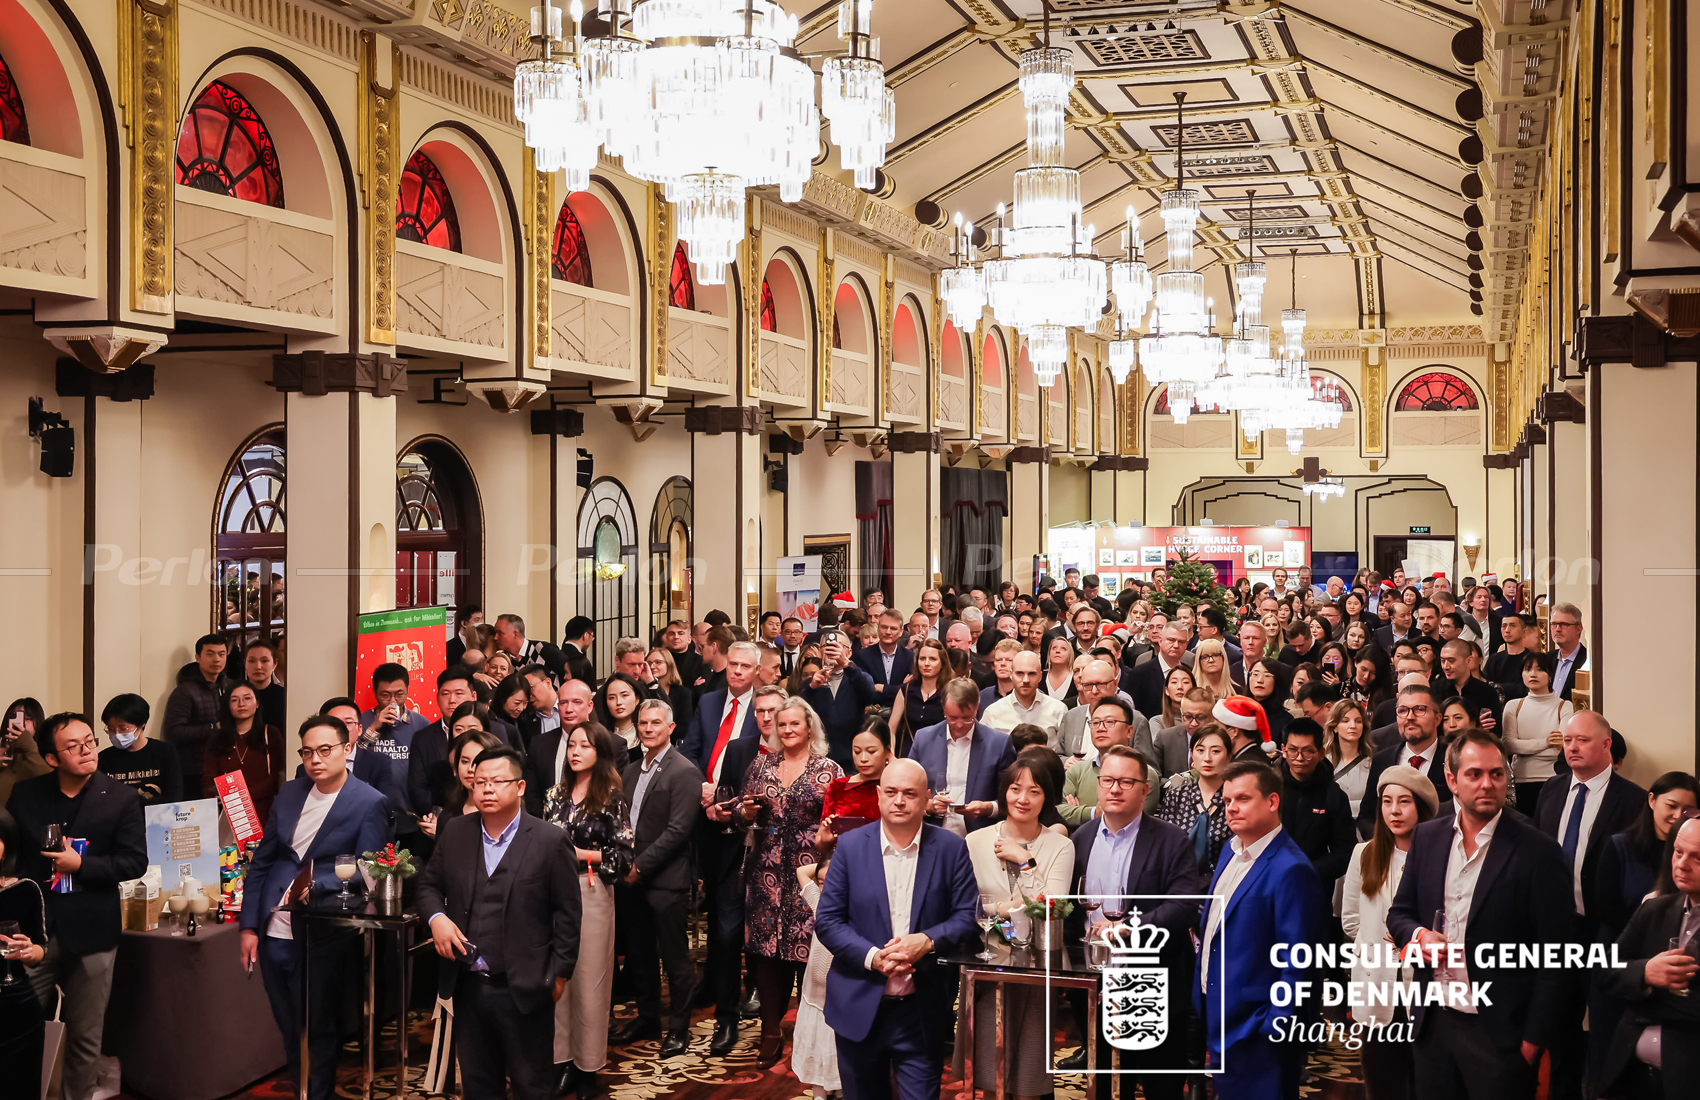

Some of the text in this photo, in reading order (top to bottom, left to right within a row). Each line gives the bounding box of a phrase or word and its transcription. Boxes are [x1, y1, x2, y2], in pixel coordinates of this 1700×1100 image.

[1172, 536, 1239, 544] SUSTAINABLE
[1203, 545, 1243, 554] CORNER
[382, 745, 409, 754] AALTO
